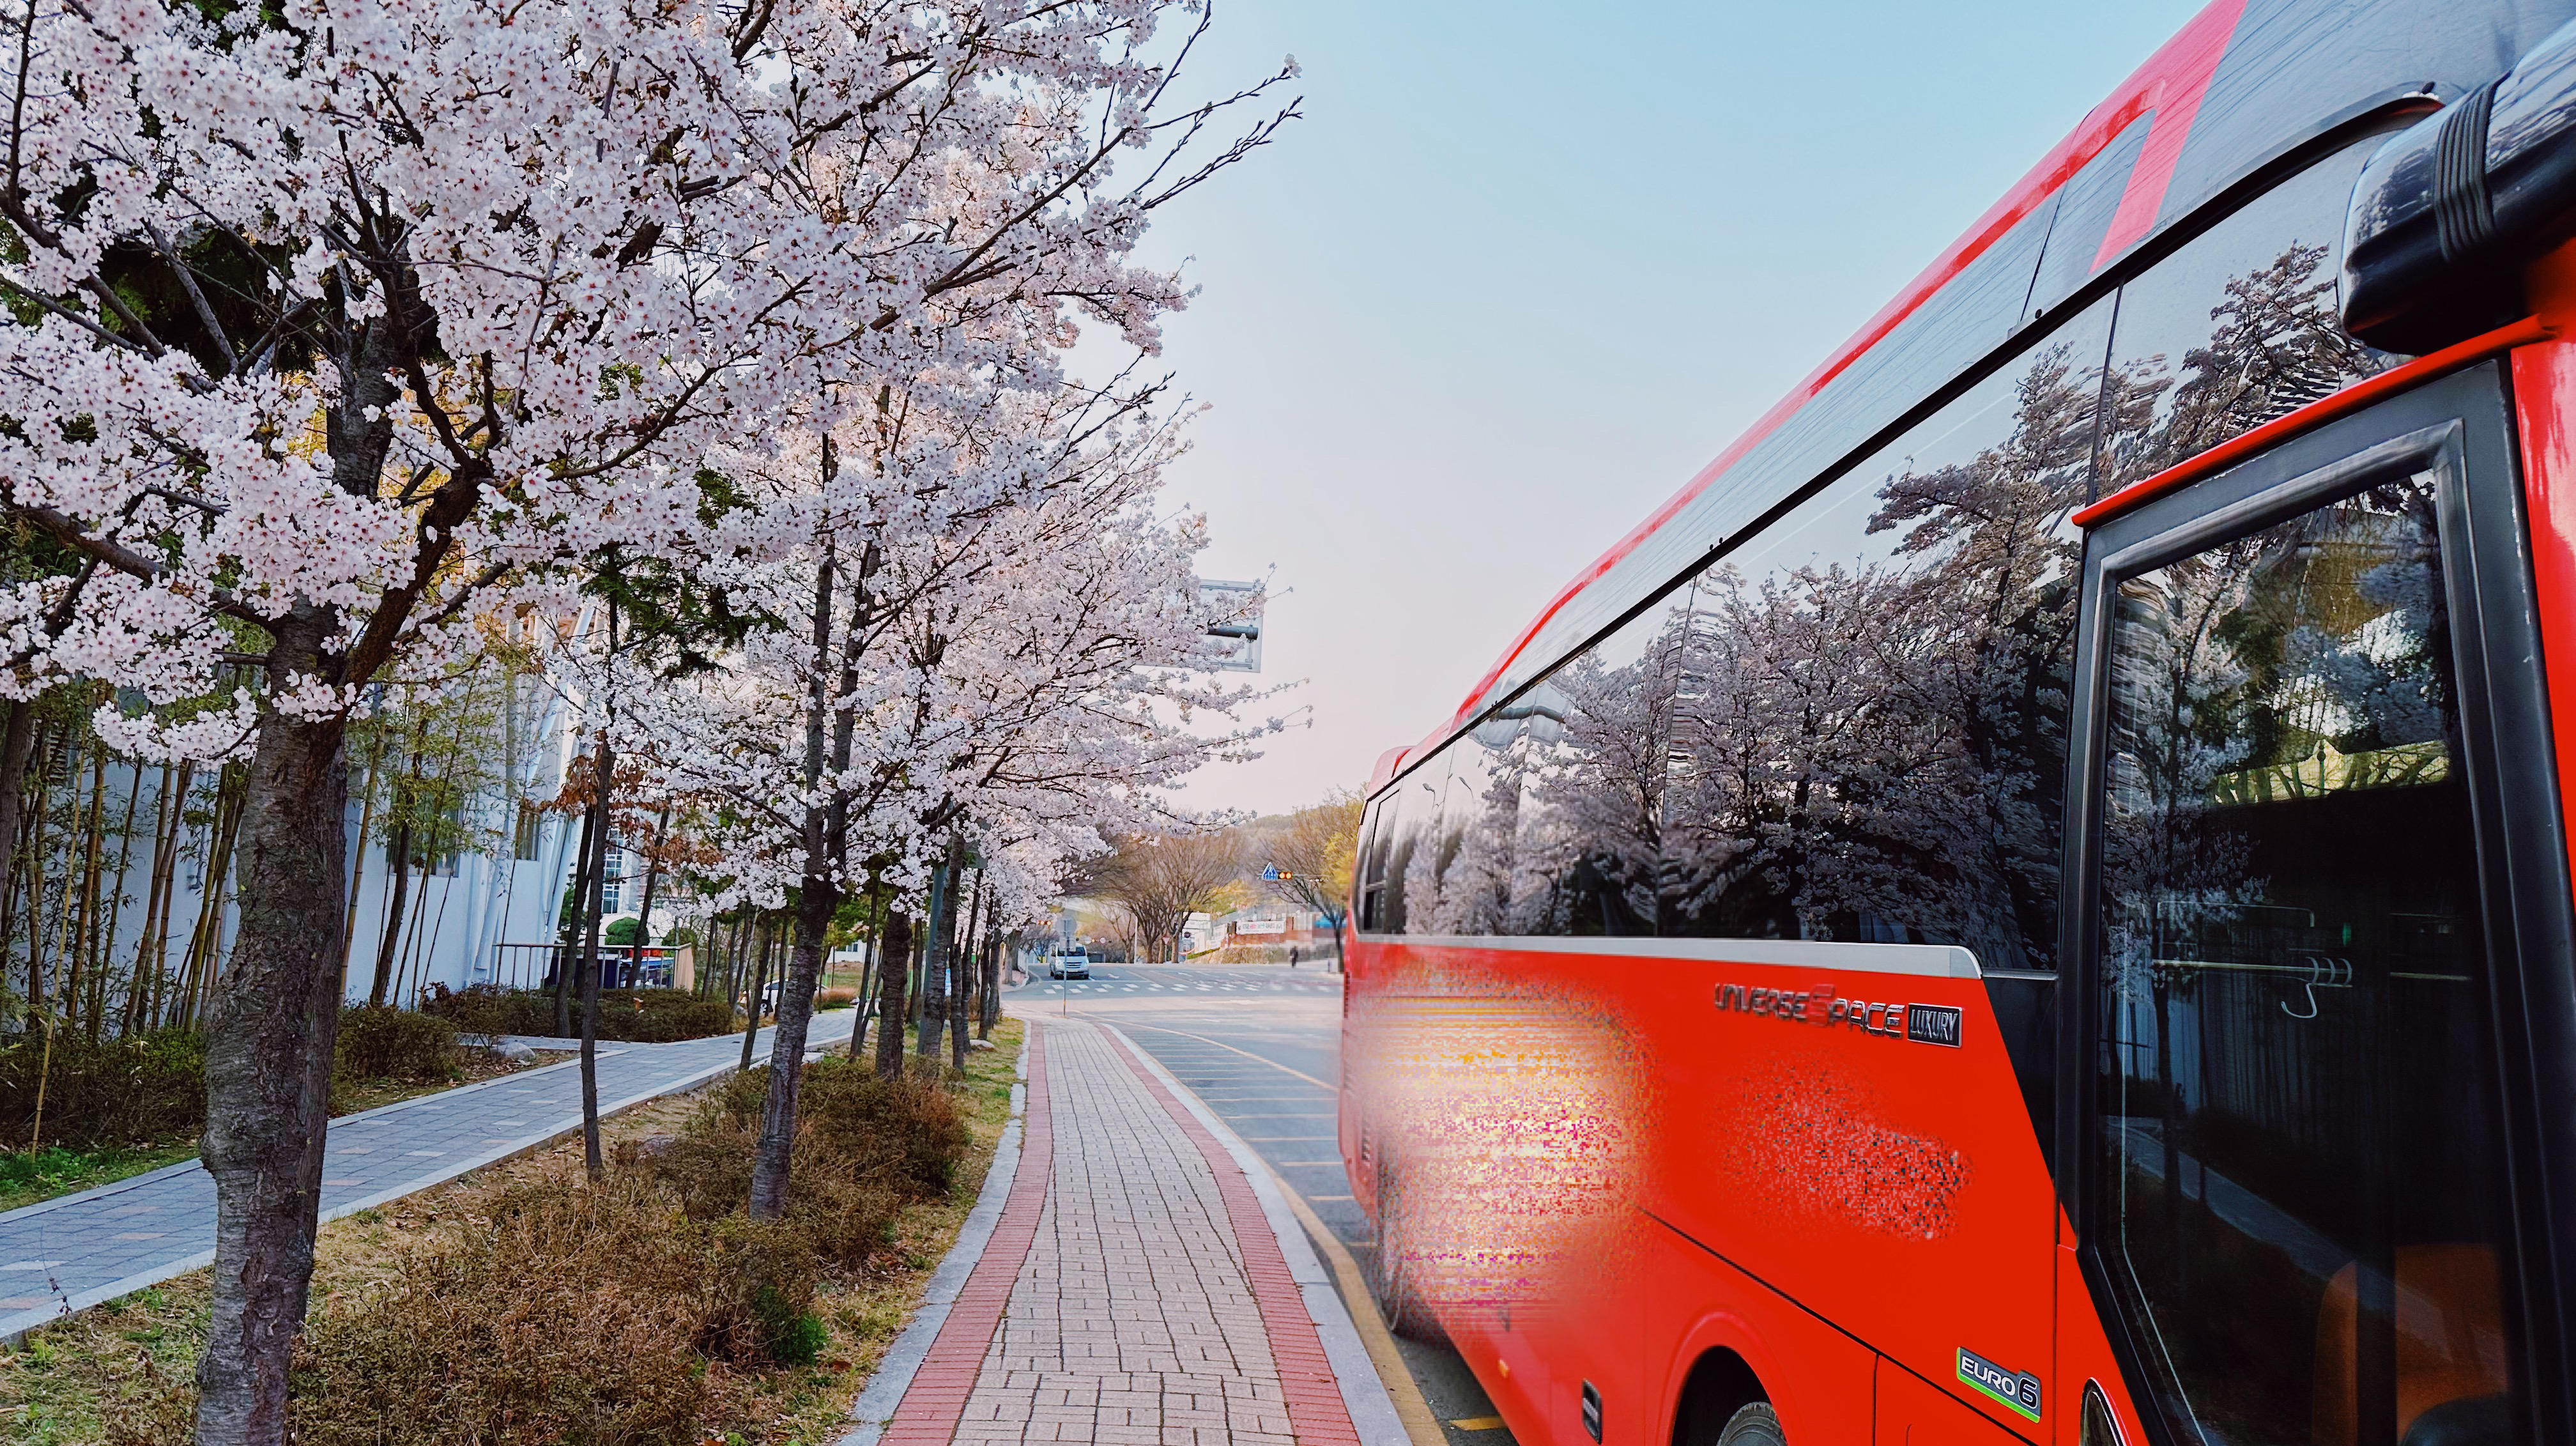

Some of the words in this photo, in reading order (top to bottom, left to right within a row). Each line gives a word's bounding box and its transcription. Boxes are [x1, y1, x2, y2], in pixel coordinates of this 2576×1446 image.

[1910, 1009, 1958, 1041] LUXURY
[1961, 1355, 2016, 1396] EURO
[2018, 1377, 2038, 1410] 6
